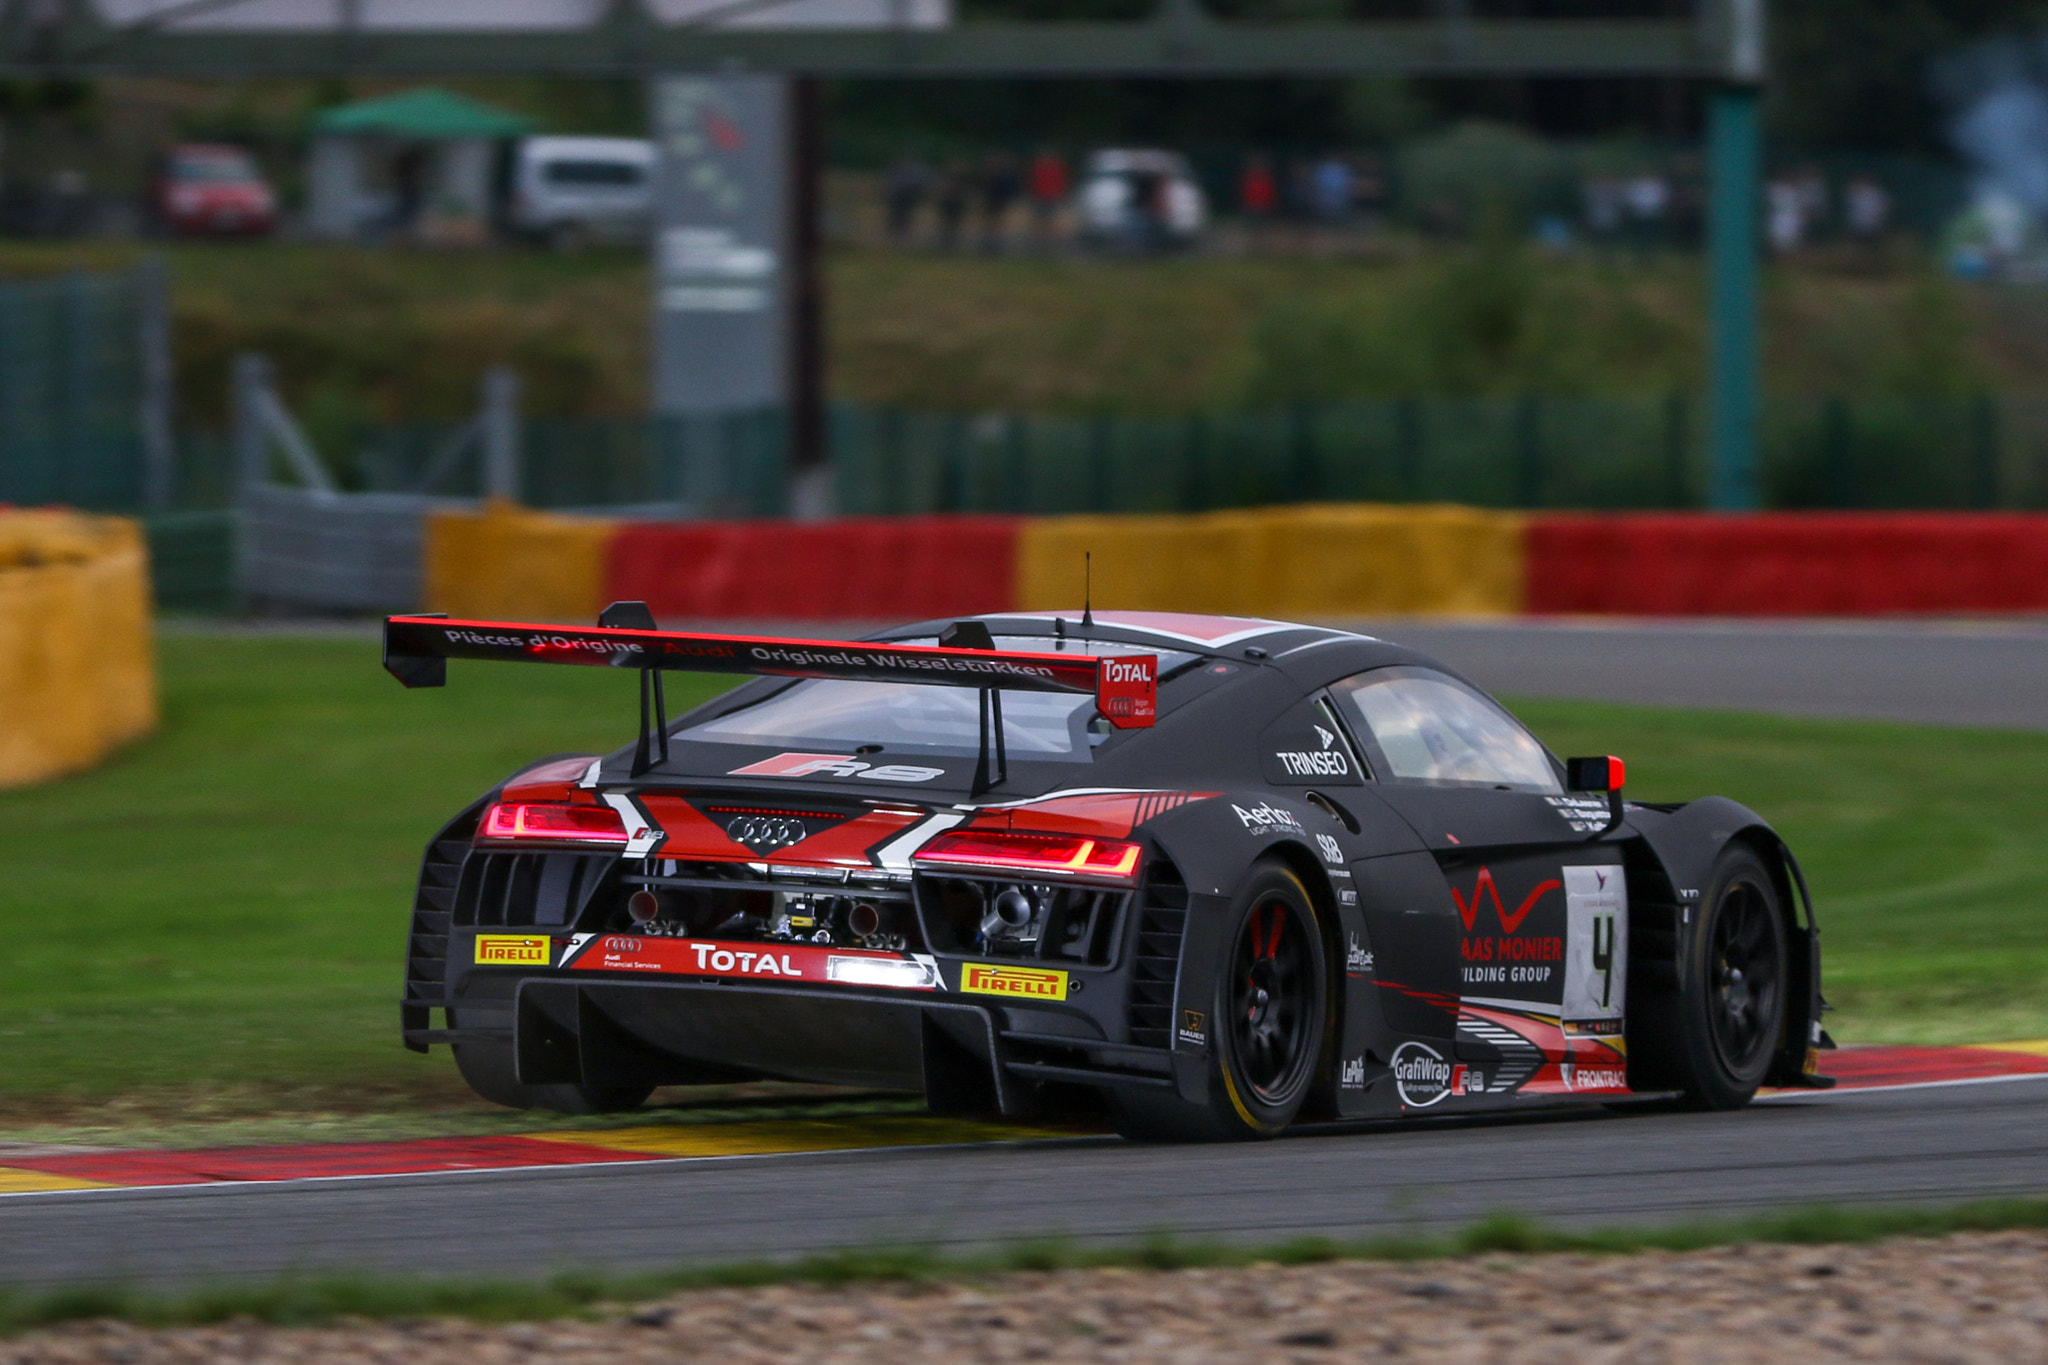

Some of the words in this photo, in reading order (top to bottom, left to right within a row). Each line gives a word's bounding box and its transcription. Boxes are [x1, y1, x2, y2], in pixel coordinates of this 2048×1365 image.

[444, 630, 523, 646] Pièces
[529, 634, 644, 653] d'Origine
[664, 642, 736, 658] Audi
[751, 647, 867, 666] Originele
[868, 653, 1054, 677] Wisselstukken
[1103, 659, 1152, 682] TOTAL
[779, 759, 946, 782] R8
[1276, 751, 1348, 775] TRINSEO
[480, 939, 544, 960] PIRELLI
[691, 943, 803, 977] TOTAL
[1461, 937, 1493, 961] AAS
[1498, 937, 1562, 961] MONIER
[604, 960, 633, 968] Financial
[1462, 966, 1506, 982] ILDING
[1511, 966, 1551, 982] GROUP
[1592, 913, 1615, 1011] 4
[969, 967, 1060, 995] PIRELLI
[1394, 1056, 1450, 1087] GrafiWrap
[1458, 1071, 1485, 1093] R8
